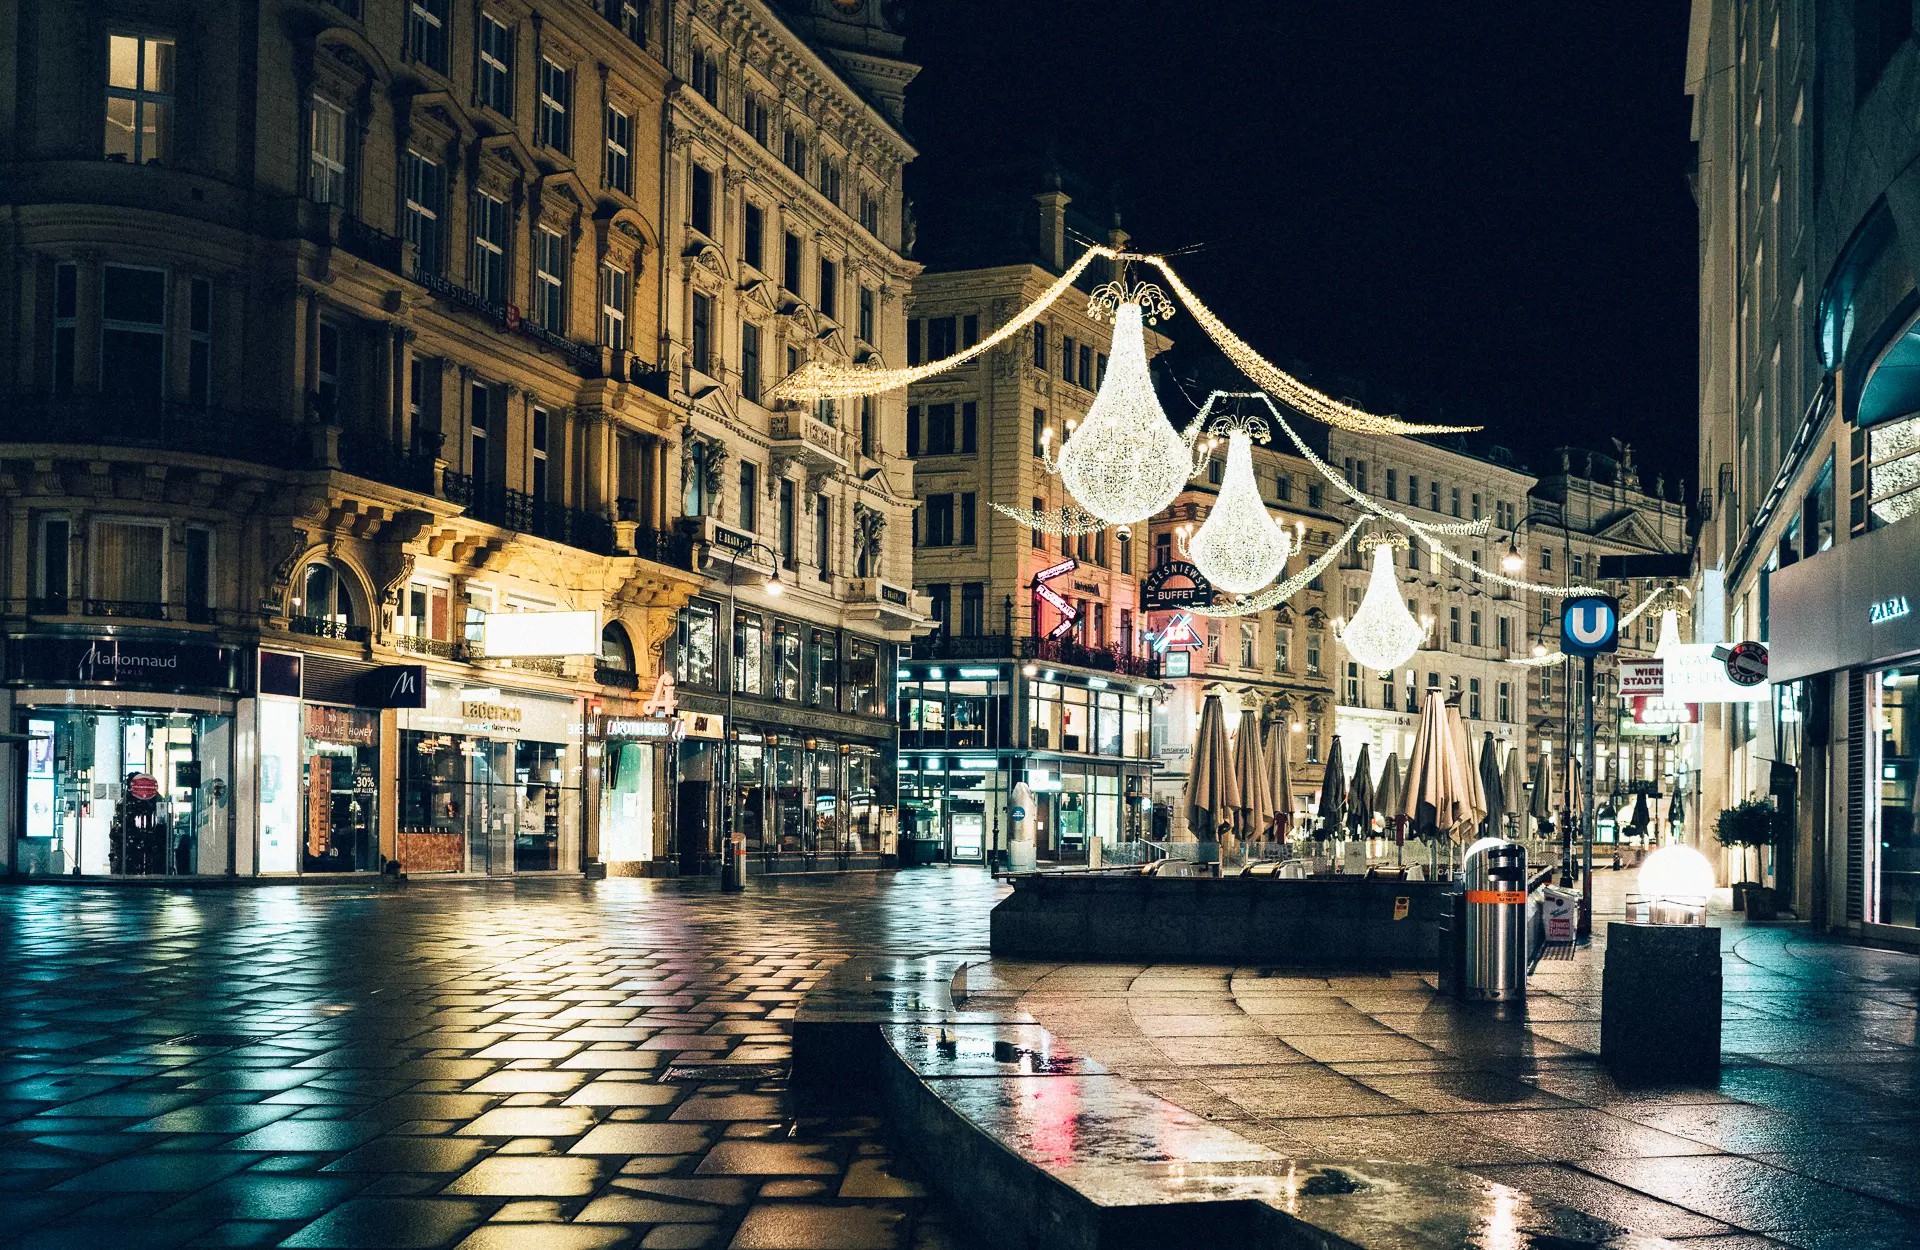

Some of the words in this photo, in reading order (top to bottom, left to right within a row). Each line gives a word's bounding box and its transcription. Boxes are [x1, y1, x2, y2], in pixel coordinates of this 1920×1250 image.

[1158, 589, 1195, 600] BUFFET
[1869, 597, 1909, 623] ZARA
[1572, 606, 1608, 644] U
[78, 647, 177, 668] Marionnaud
[115, 668, 143, 676] PARIS
[390, 671, 414, 699] M
[310, 724, 331, 734] SPOIL
[348, 728, 373, 737] HONEY
[352, 776, 375, 788] -30%
